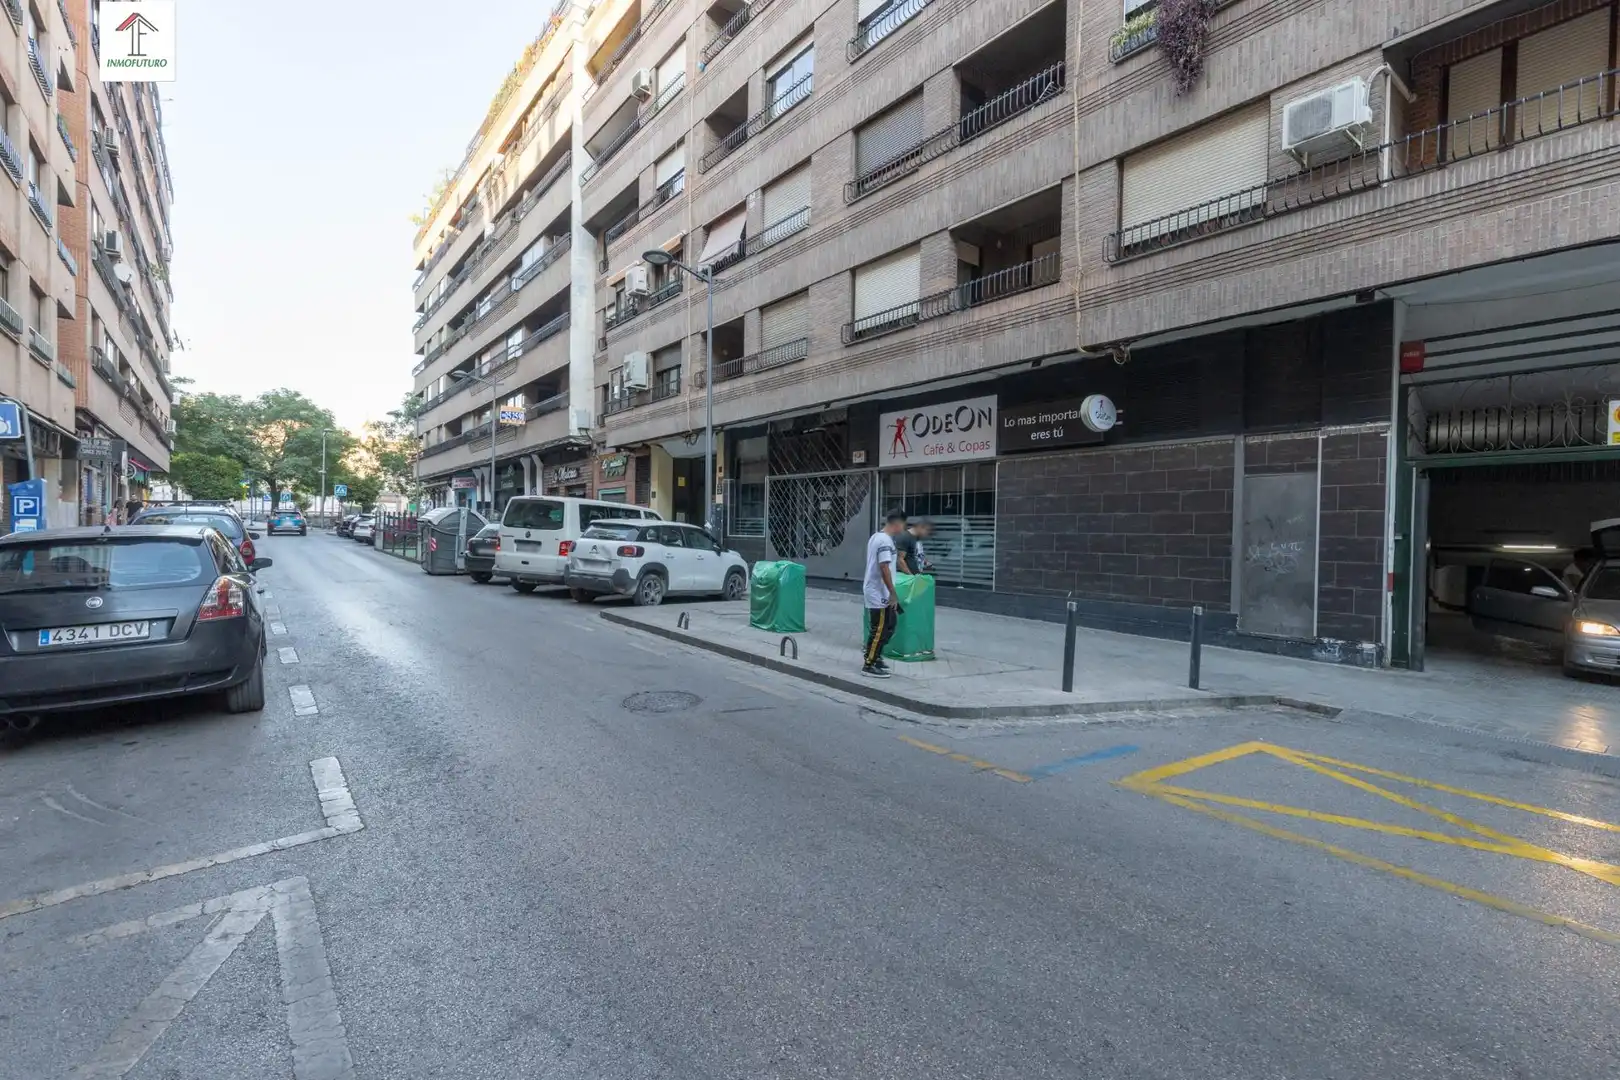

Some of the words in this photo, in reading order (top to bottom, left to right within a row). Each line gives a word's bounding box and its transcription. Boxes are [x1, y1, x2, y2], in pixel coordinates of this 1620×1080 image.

[1004, 418, 1015, 428] Lo
[1017, 416, 1036, 425] mas
[1031, 430, 1050, 440] eres
[1053, 426, 1064, 438] tú
[923, 442, 943, 456] Café
[947, 442, 955, 454] &
[958, 440, 991, 452] Copas
[19, 499, 35, 513] P
[52, 626, 99, 642] 4341
[109, 622, 144, 638] DCV
